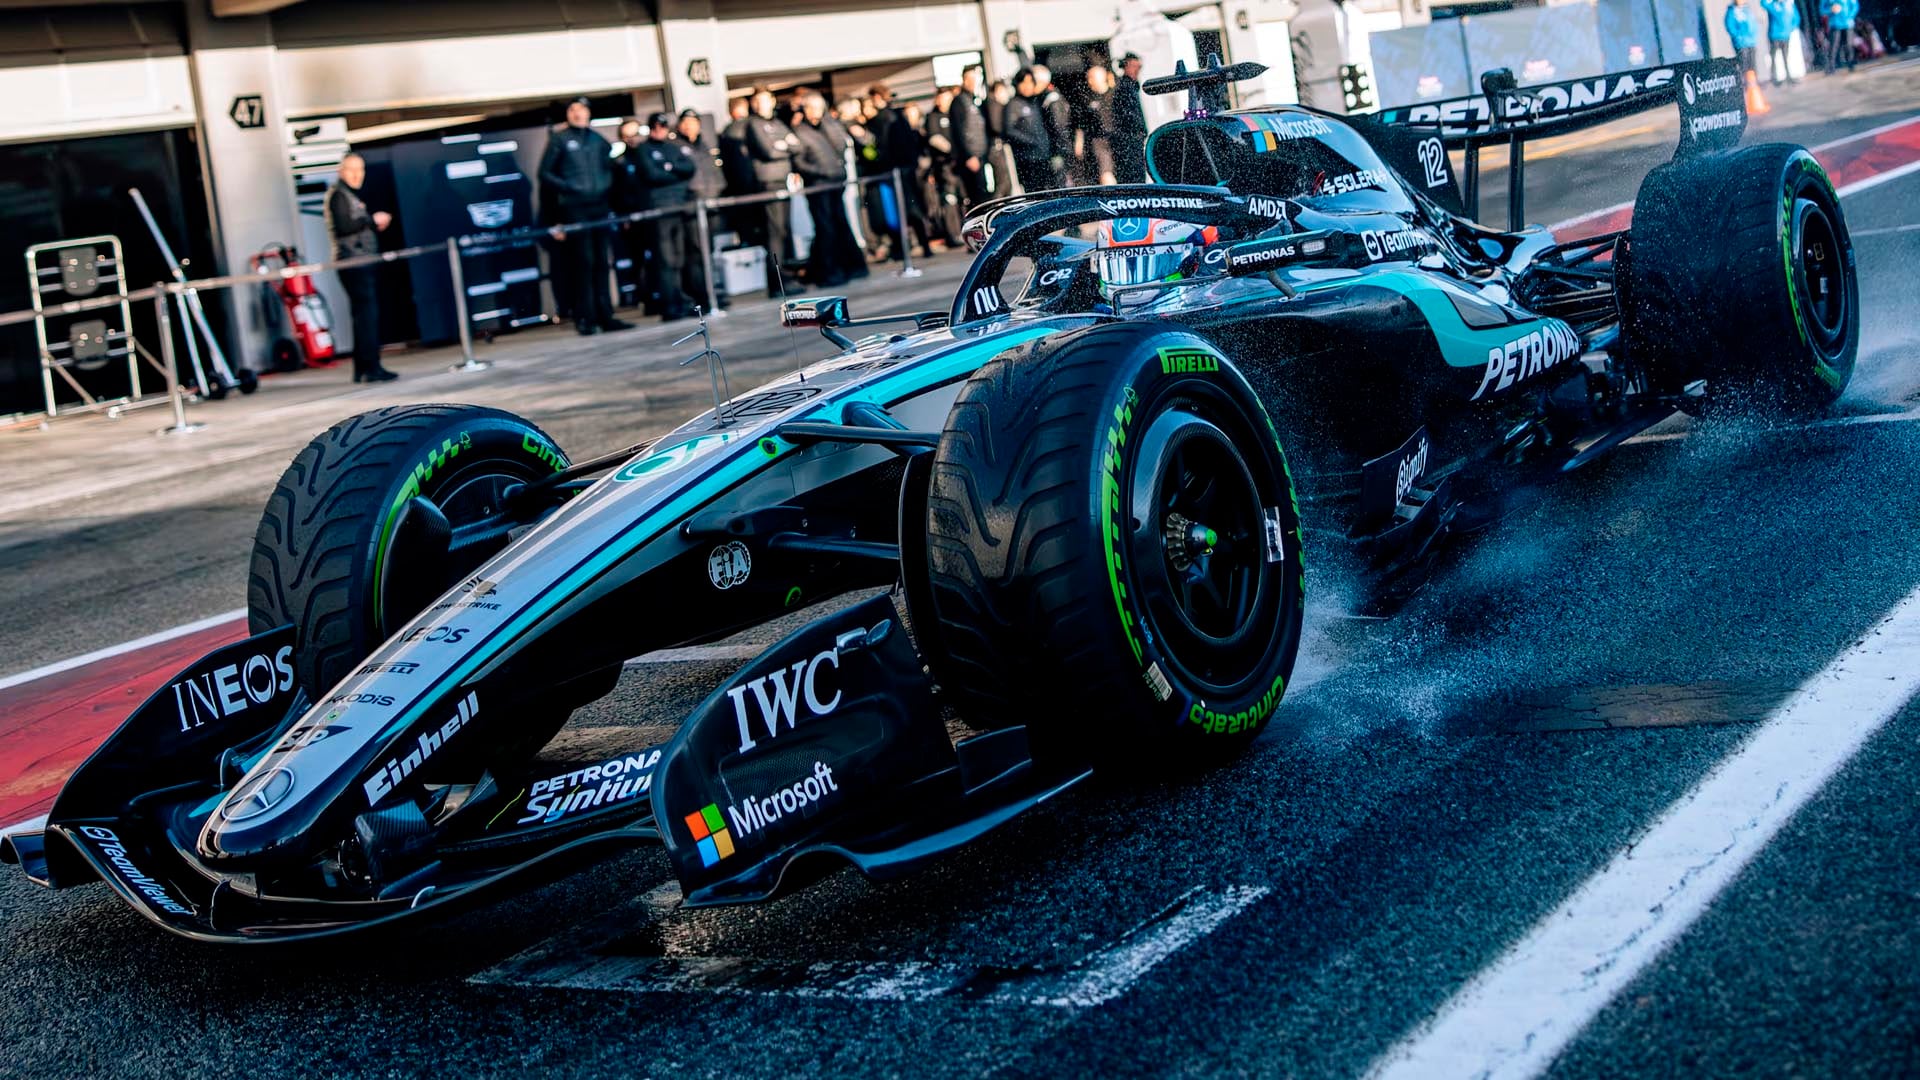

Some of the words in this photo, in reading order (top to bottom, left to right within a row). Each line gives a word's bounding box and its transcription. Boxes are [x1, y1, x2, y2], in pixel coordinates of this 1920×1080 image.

[1695, 73, 1737, 96] Snapdragon
[234, 98, 260, 126] 47
[1268, 114, 1333, 141] Microsoft
[1417, 136, 1448, 188] 12
[1334, 168, 1388, 194] SOLERA
[1106, 197, 1204, 210] CROWDSTRIKE
[1248, 197, 1276, 218] AMD
[1232, 246, 1295, 266] PETRONAS
[1156, 346, 1219, 375] PIRELLI
[172, 645, 294, 732] INEOS
[727, 647, 842, 754] IWC
[363, 689, 480, 808] Einhell
[530, 749, 662, 797] PETRONA
[727, 760, 839, 839] Microsoft
[98, 841, 195, 915] TeamViewer
